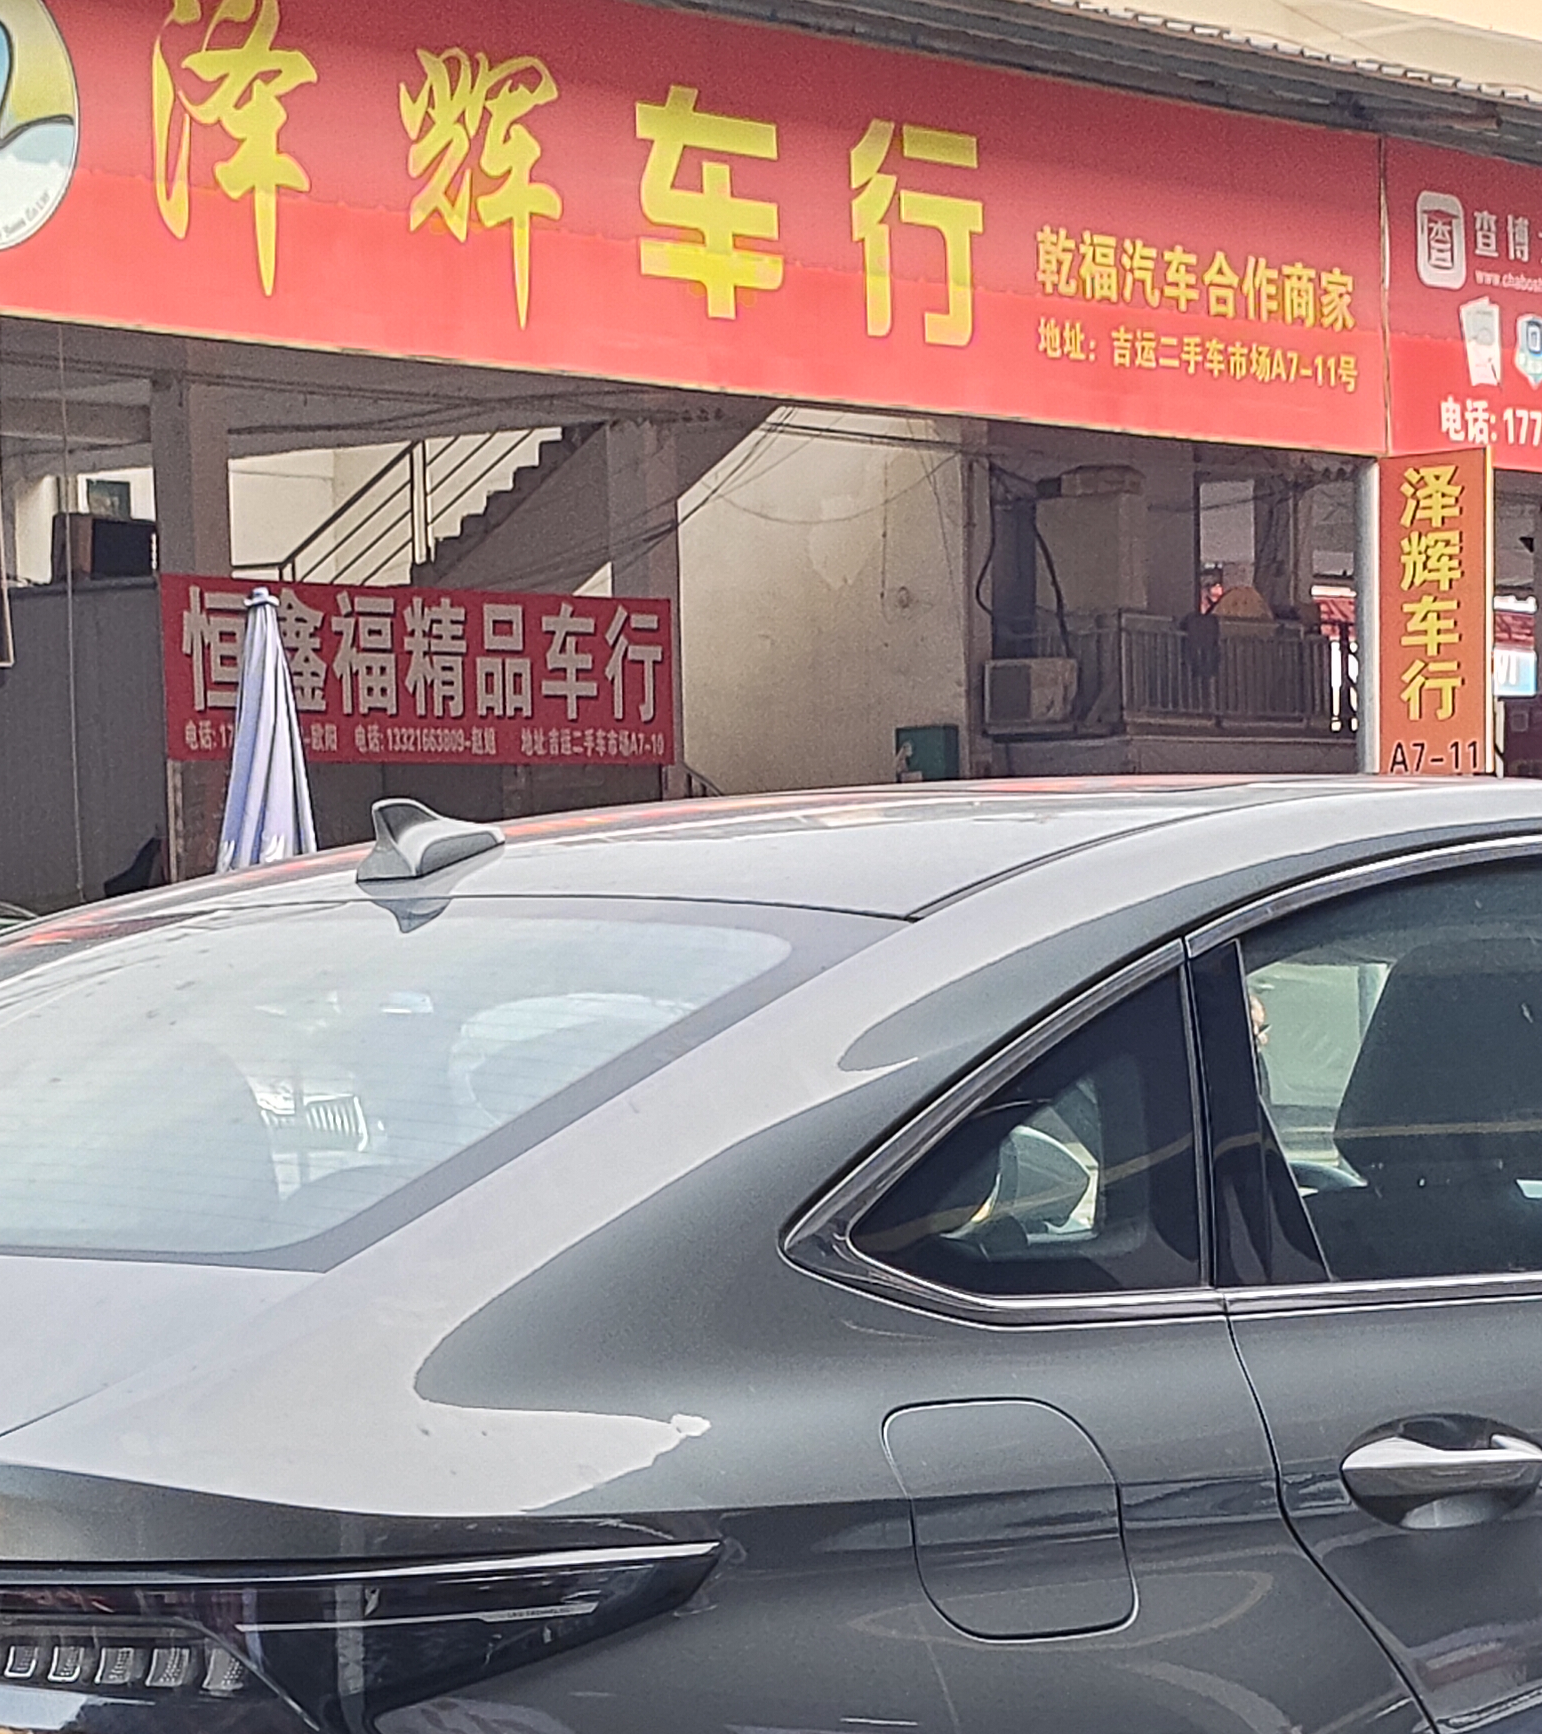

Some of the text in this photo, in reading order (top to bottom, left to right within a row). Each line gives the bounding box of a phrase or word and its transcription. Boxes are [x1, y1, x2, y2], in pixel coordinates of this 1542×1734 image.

[153, 0, 983, 346] 泽辉车行
[1035, 224, 1356, 332] 乾福汽车合作商家
[181, 586, 663, 722] 恒鑫福精品车行
[1400, 465, 1464, 722] 泽辉车行
[1388, 740, 1479, 775] A7-11
